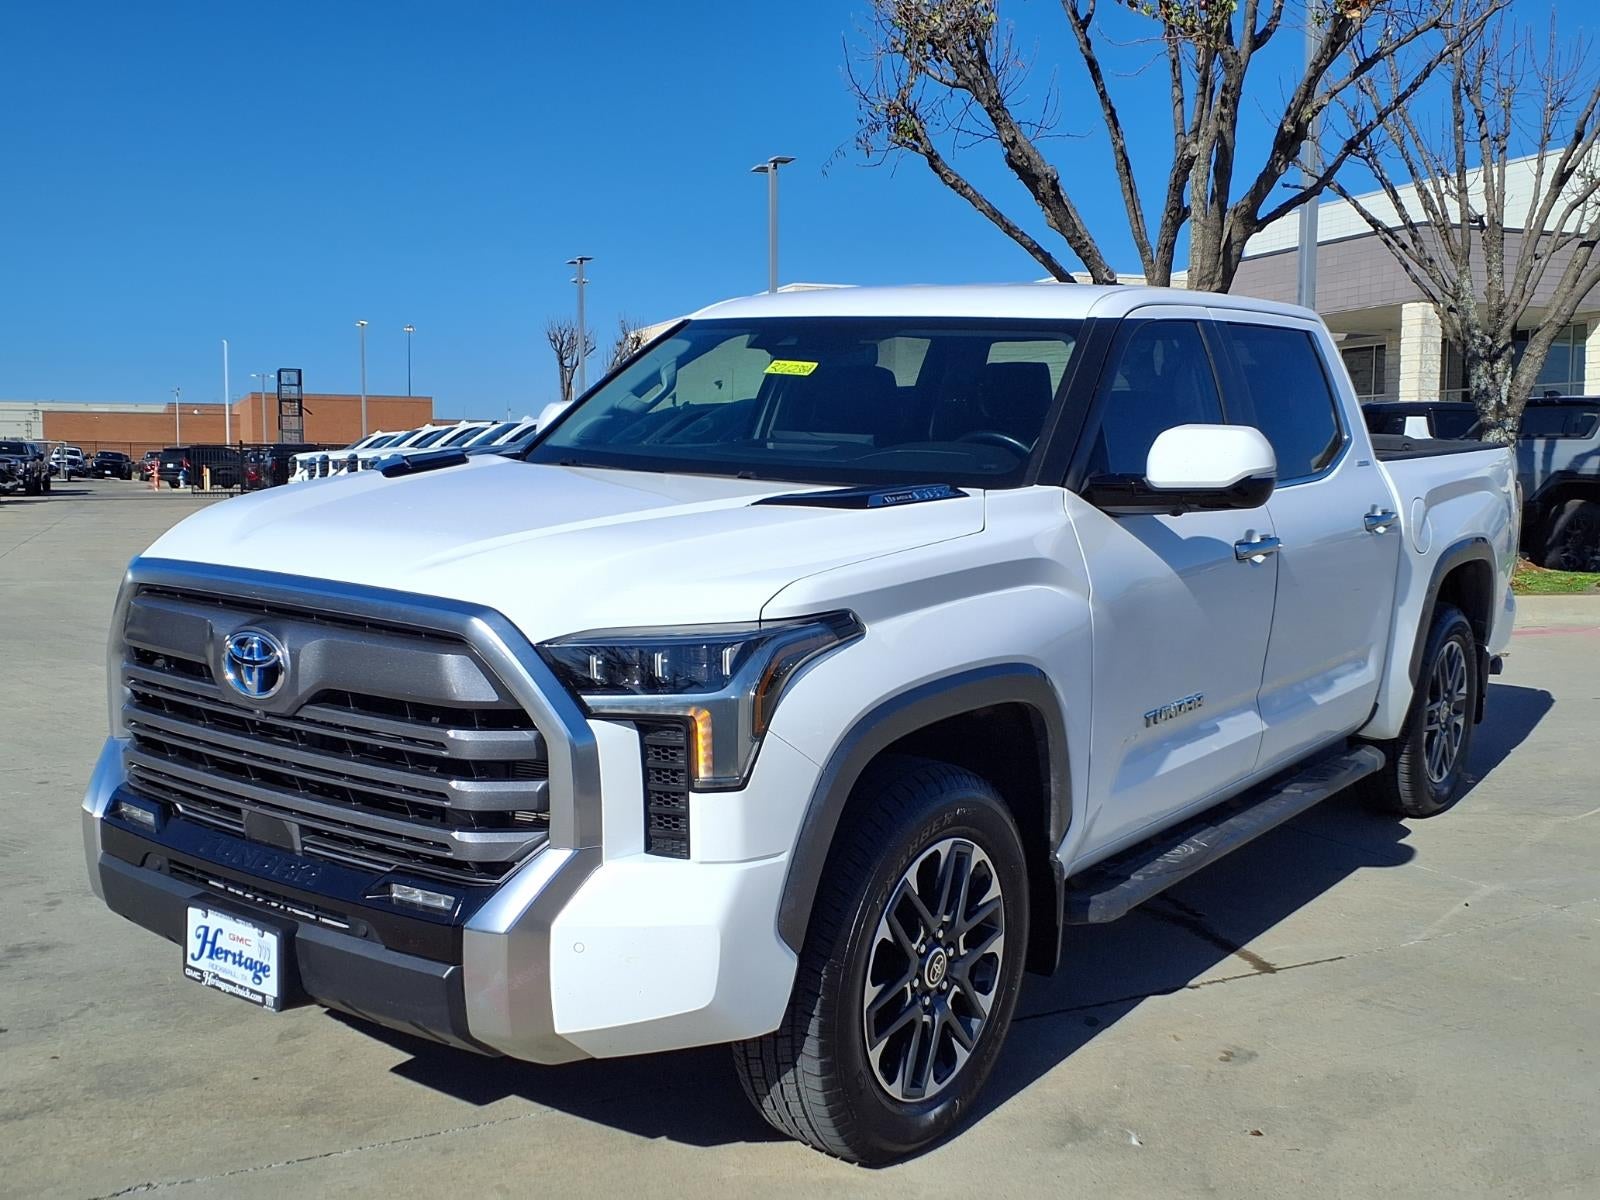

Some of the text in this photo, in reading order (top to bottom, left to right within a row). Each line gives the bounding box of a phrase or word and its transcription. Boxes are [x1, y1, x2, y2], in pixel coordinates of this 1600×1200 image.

[1144, 691, 1204, 728] TUNDRA
[190, 925, 270, 985] Heritage
[228, 933, 252, 947] GMC
